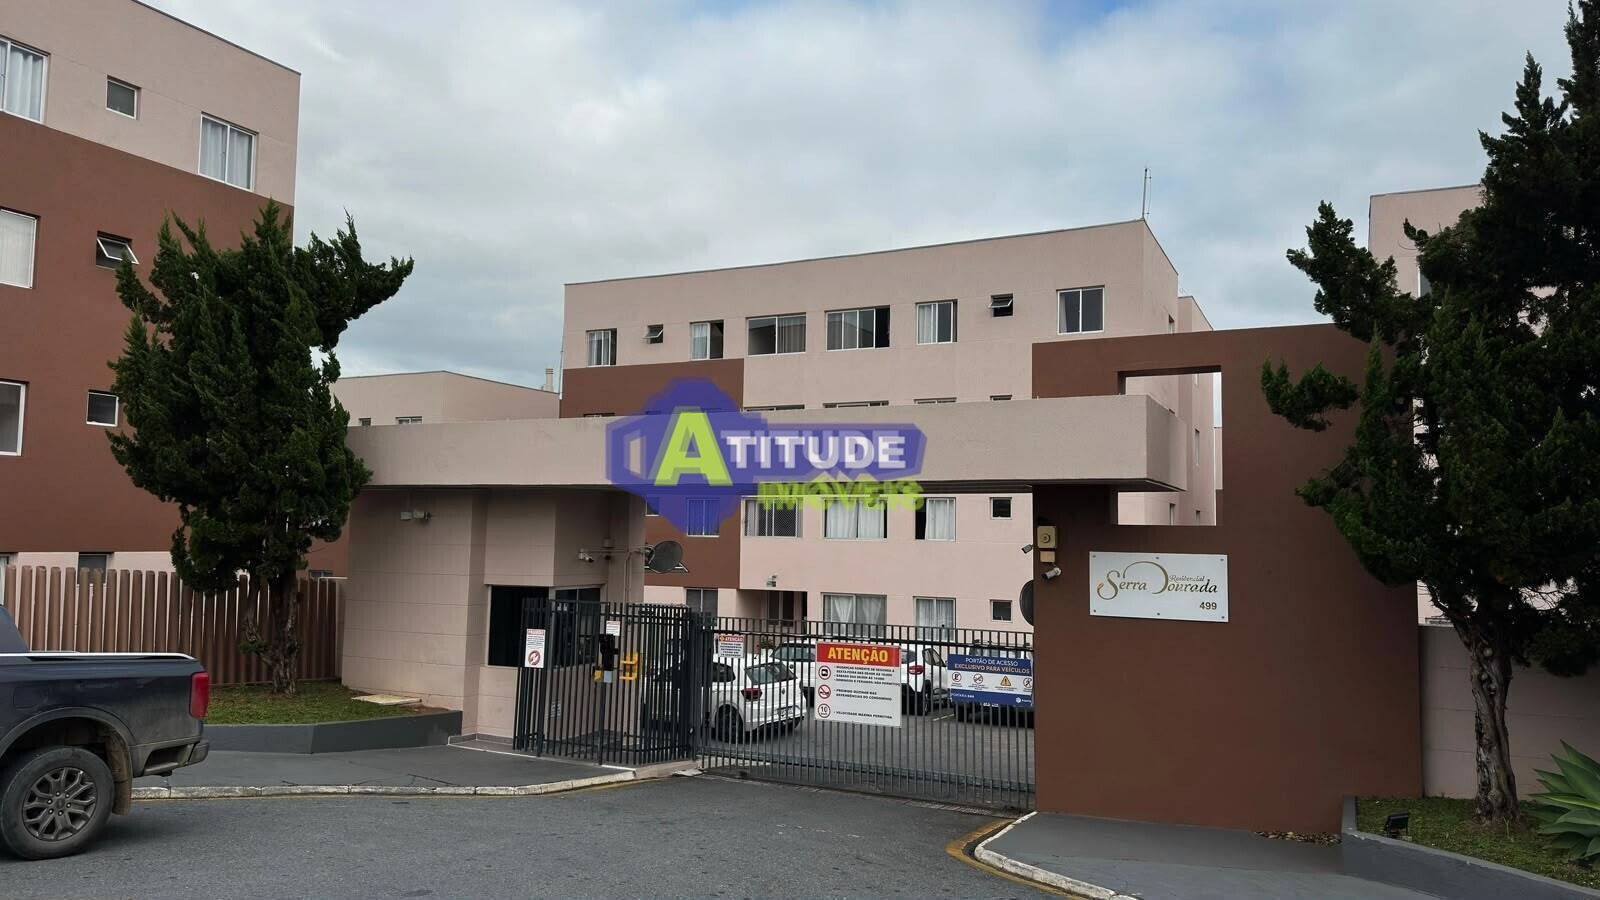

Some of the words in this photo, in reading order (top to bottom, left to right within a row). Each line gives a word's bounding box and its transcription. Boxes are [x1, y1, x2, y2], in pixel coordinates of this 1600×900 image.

[1097, 570, 1147, 600] Serra
[1122, 561, 1218, 594] Dourada
[1200, 602, 1218, 610] 499
[828, 646, 888, 664] ATENÇÃO
